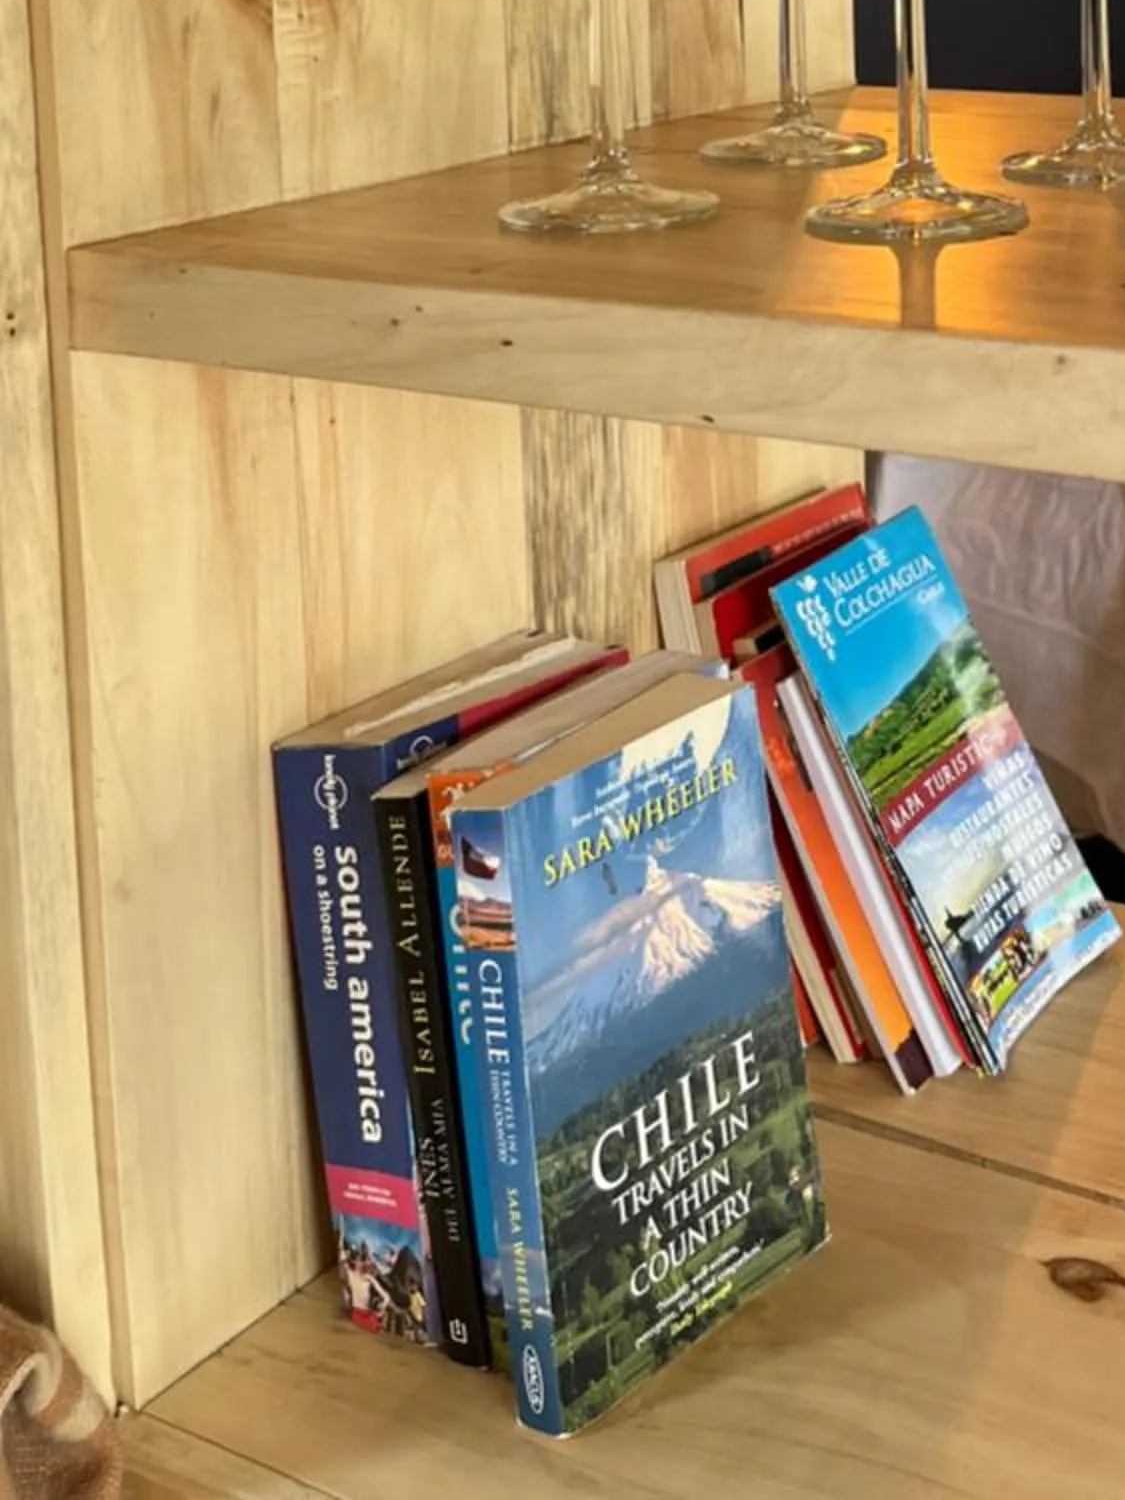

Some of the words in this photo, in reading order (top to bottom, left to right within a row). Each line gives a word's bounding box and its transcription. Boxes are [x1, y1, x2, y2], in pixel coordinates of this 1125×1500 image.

[823, 561, 869, 597] VALLE
[867, 548, 891, 576] DE
[834, 553, 936, 627] COLCHAGUA
[313, 844, 327, 870] on
[543, 828, 612, 888] SARA
[618, 757, 738, 841] WHEELER
[887, 791, 925, 835] MAPA
[316, 874, 328, 887] a
[335, 845, 373, 964] south
[389, 815, 421, 957] ALLENDE
[317, 890, 339, 990] shoestring
[348, 977, 384, 1144] america
[408, 970, 436, 1075] ISABEL
[479, 958, 510, 1064] CHILE
[591, 1030, 761, 1191] CHILE
[506, 1187, 521, 1234] SARA
[612, 1131, 716, 1226] TRAVELS
[719, 1103, 749, 1149] IN
[643, 1214, 662, 1250] A
[663, 1158, 733, 1229] THIN
[513, 1241, 534, 1331] WHEELER
[630, 1181, 753, 1298] COUNTRY
